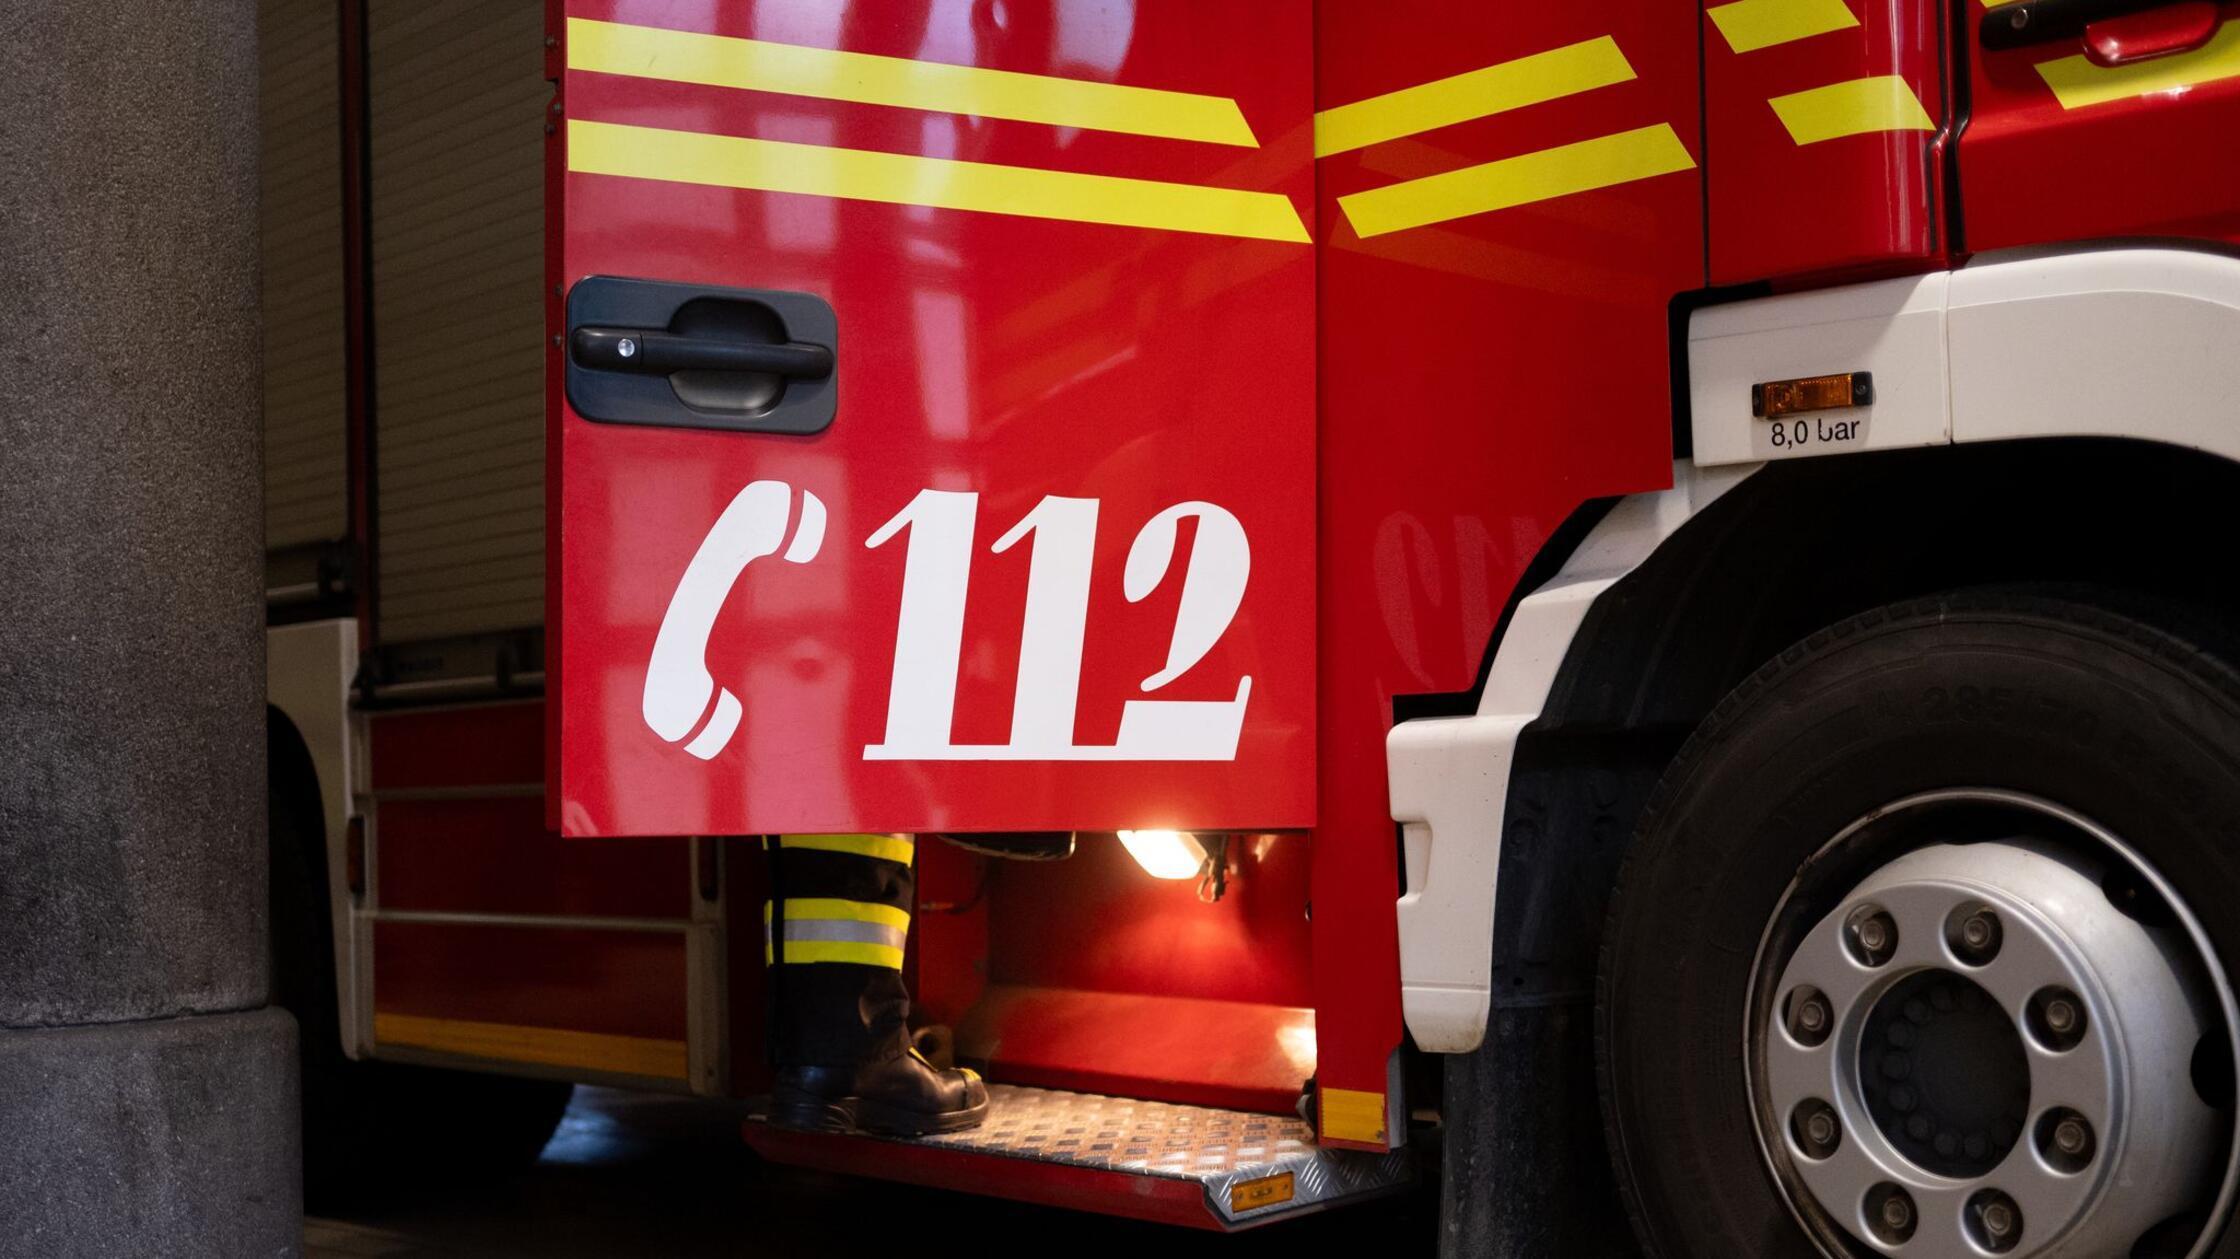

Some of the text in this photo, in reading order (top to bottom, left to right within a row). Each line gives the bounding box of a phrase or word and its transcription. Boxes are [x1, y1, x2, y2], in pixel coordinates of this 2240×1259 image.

[1771, 418, 1860, 449] 8,0 bar
[863, 488, 1252, 760] 112
